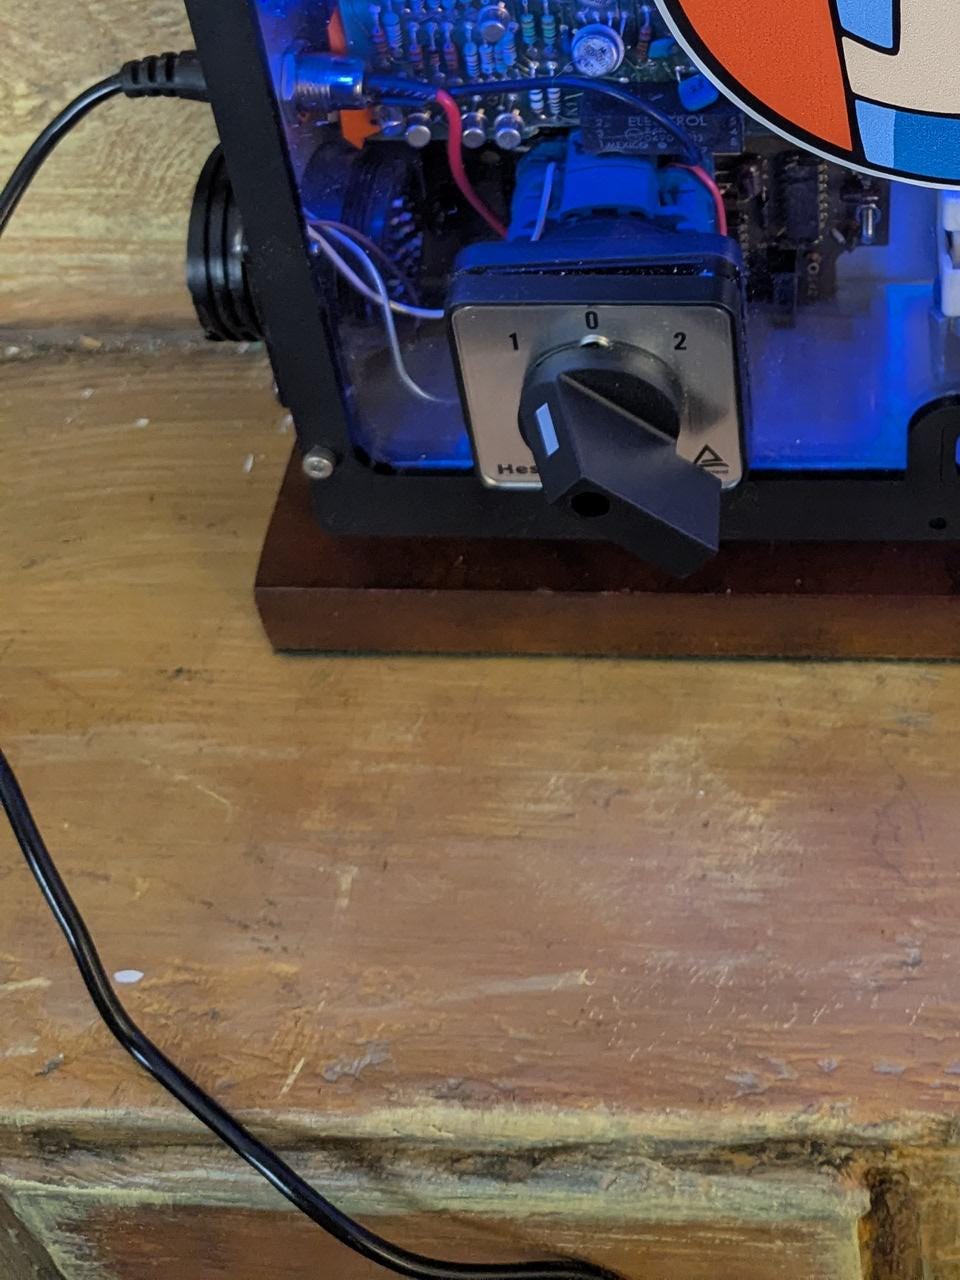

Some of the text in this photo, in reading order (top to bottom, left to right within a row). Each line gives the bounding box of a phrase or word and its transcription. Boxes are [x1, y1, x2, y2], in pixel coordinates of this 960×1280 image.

[584, 310, 600, 330] 0
[508, 332, 520, 351] 1
[672, 331, 688, 351] 2
